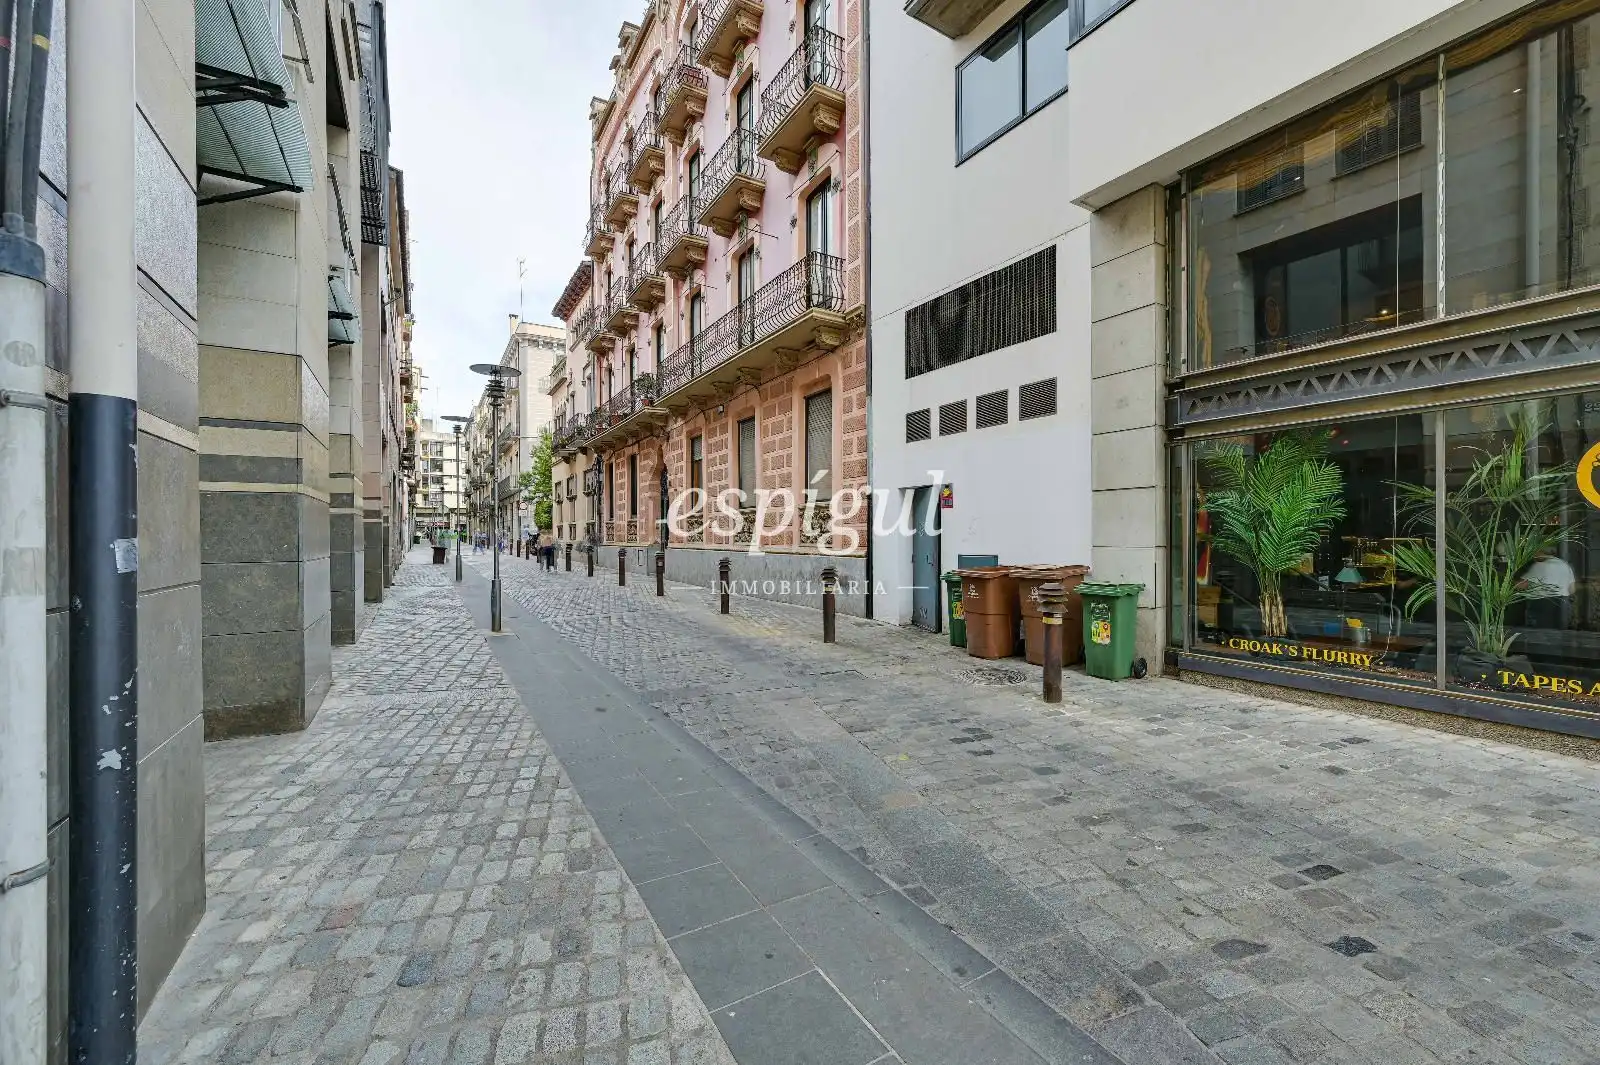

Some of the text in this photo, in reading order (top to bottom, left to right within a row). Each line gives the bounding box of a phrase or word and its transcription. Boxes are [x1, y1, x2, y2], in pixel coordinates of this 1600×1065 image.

[1229, 637, 1374, 667] CROAK'S FLURRY
[1497, 670, 1583, 695] TAPES
